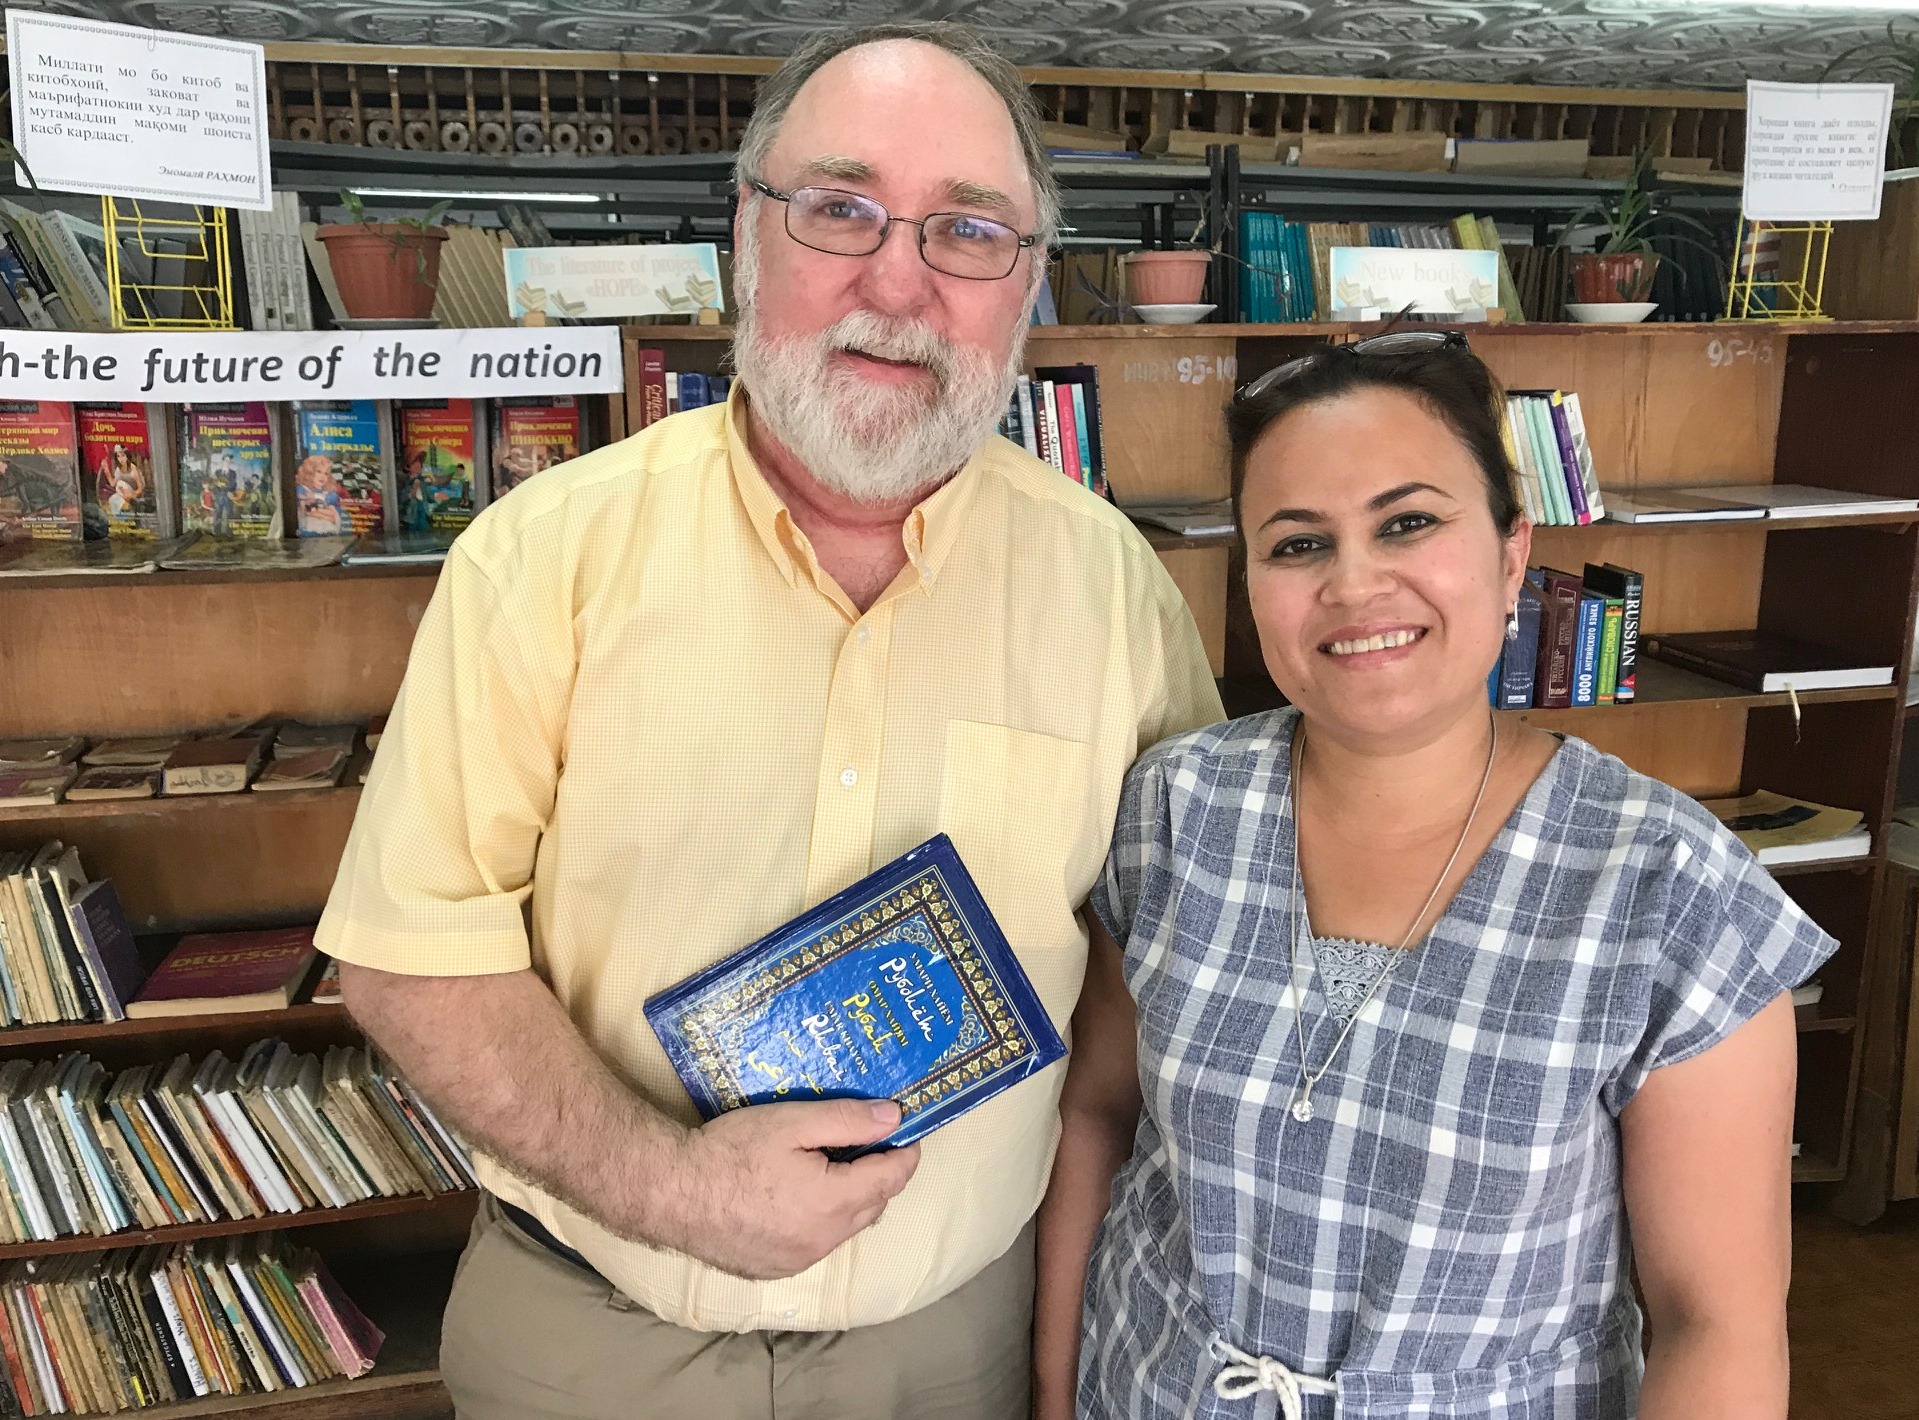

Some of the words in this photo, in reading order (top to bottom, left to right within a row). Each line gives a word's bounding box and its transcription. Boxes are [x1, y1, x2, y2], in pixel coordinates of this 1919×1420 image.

[38, 54, 103, 74] Миллати
[118, 67, 137, 77] мо
[151, 68, 168, 82] бо
[182, 74, 222, 89] китоб
[235, 82, 249, 92] ва
[147, 86, 199, 102] заковат
[236, 99, 250, 109] ва
[148, 103, 171, 116] худ
[176, 106, 200, 121] дар
[30, 107, 116, 125] мутамаддин
[203, 127, 252, 141] шоиста
[31, 123, 63, 135] касб
[67, 127, 133, 144] кардааст.
[527, 257, 555, 275] The
[561, 256, 625, 275] literature
[633, 255, 648, 272] of
[652, 255, 701, 277] project
[1360, 261, 1406, 282] New
[1414, 261, 1473, 284] books
[141, 348, 284, 392] future
[298, 346, 345, 389] of
[374, 342, 441, 377] the
[470, 343, 602, 379] nation
[310, 423, 353, 438] Алиса
[510, 435, 573, 446] ПИНОККИО
[1588, 603, 1599, 626] ЯЗЫКА
[1606, 617, 1618, 653] СЛОВАРЬ
[1622, 599, 1641, 667] RUSSIAN
[1584, 627, 1597, 671] АНГЛИЙСКОГО
[1578, 673, 1593, 702] 8000
[169, 946, 301, 968] DEUTSCH
